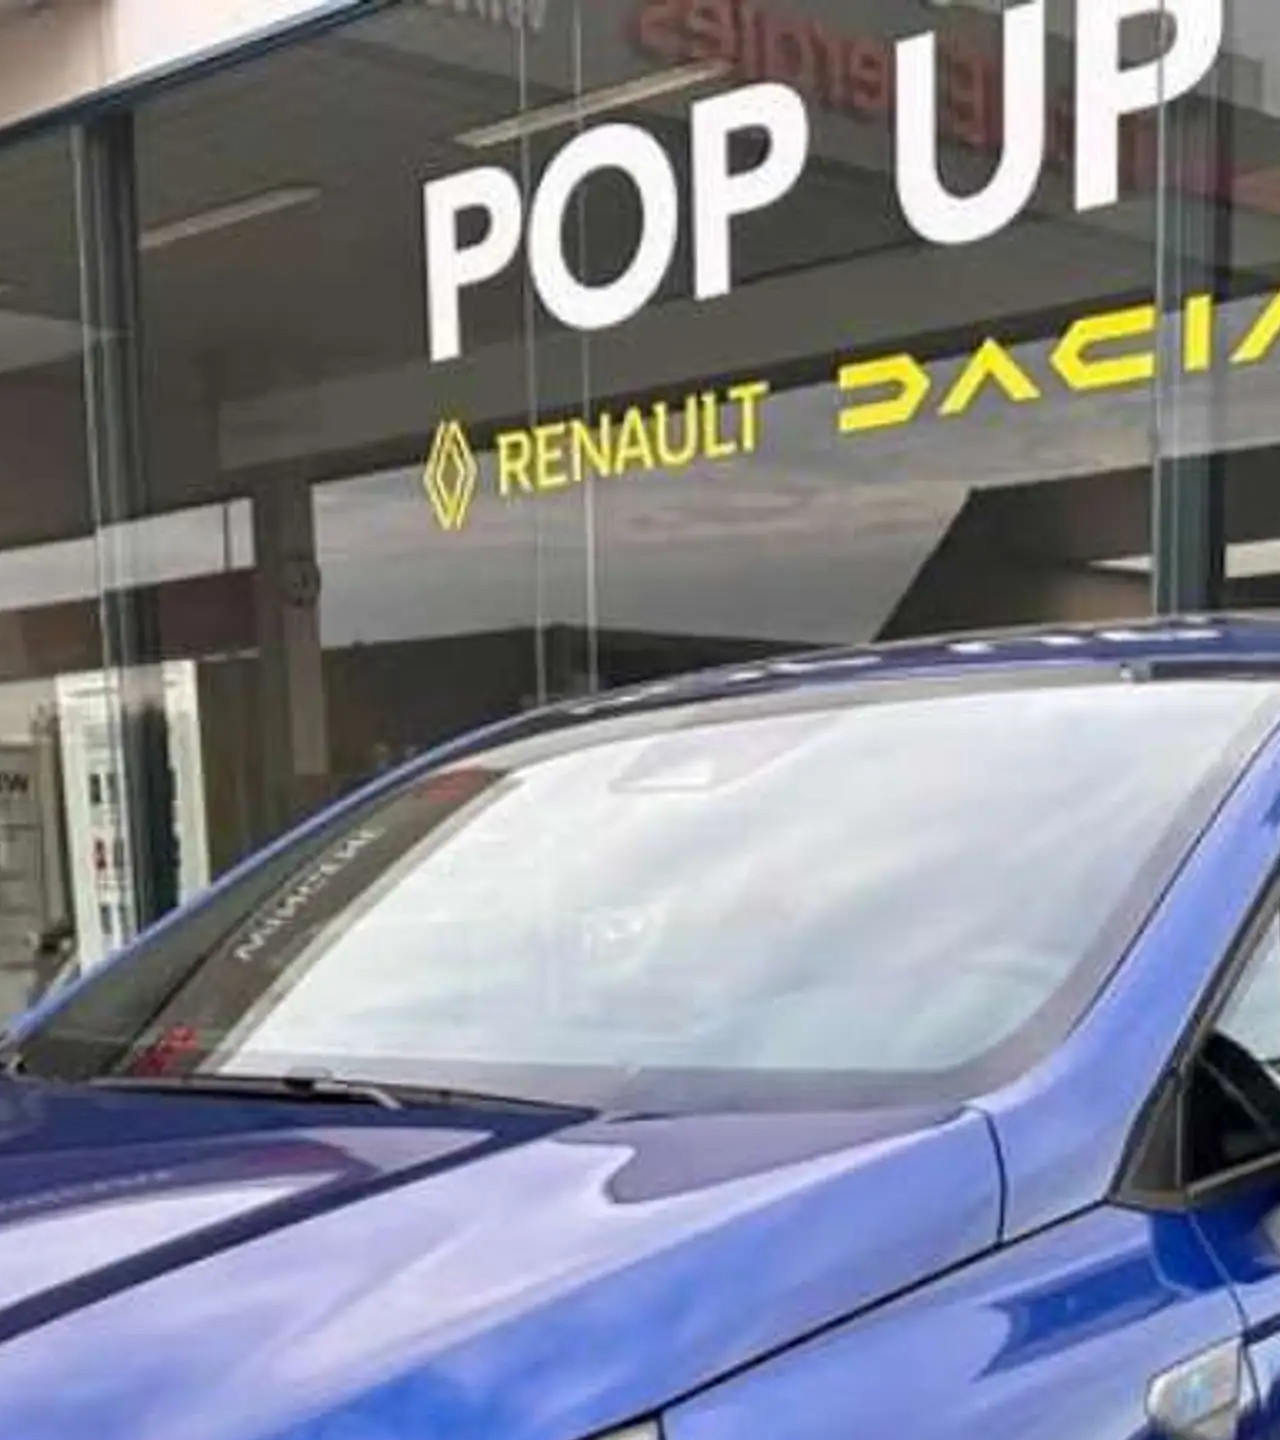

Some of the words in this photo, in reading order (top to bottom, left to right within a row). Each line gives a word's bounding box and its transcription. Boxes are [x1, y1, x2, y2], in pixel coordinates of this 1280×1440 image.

[424, 82, 809, 361] POP
[895, 0, 1226, 243] UP
[497, 383, 769, 496] RENAULT
